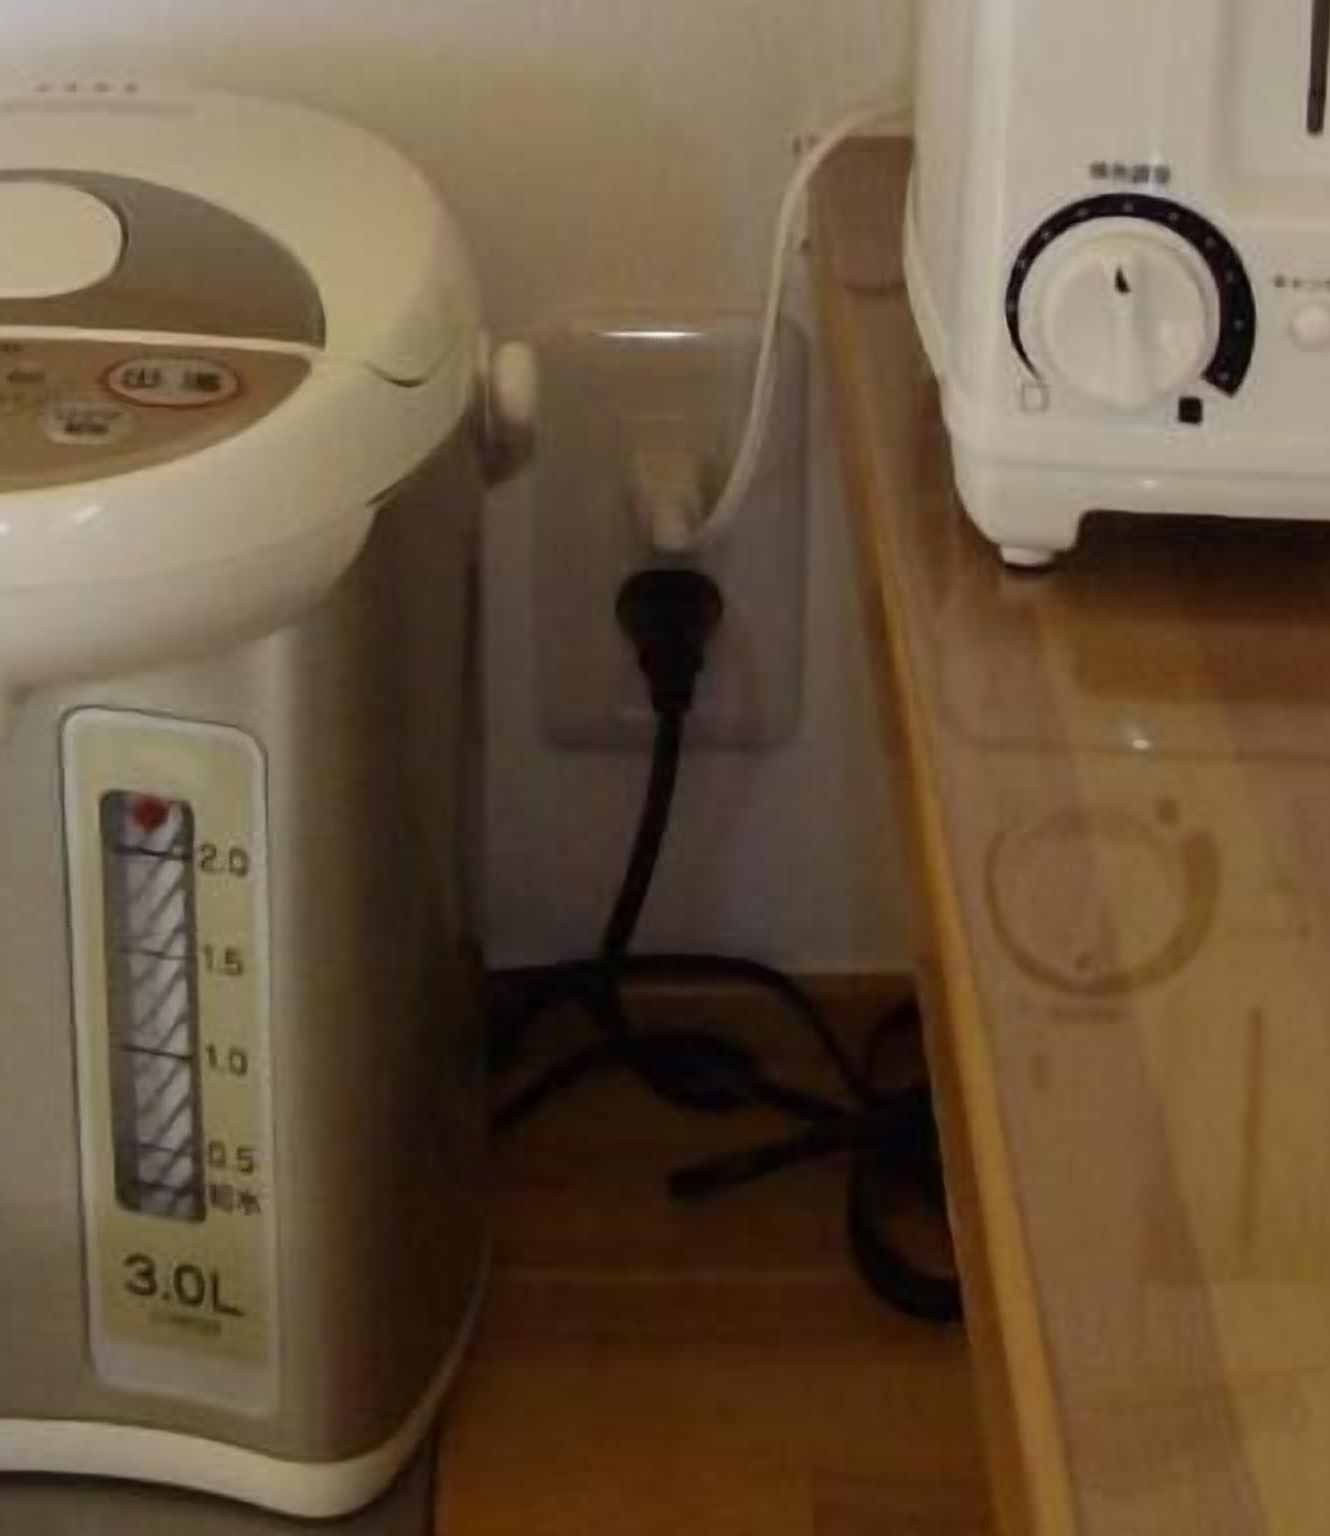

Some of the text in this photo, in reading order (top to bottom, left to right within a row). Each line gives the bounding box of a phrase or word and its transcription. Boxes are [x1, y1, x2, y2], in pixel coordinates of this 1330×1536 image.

[200, 842, 251, 878] 2.0
[203, 943, 245, 978] 1.5
[205, 1042, 250, 1077] 1.0
[207, 1139, 257, 1176] 0.5
[123, 1251, 246, 1317] 3.0L
